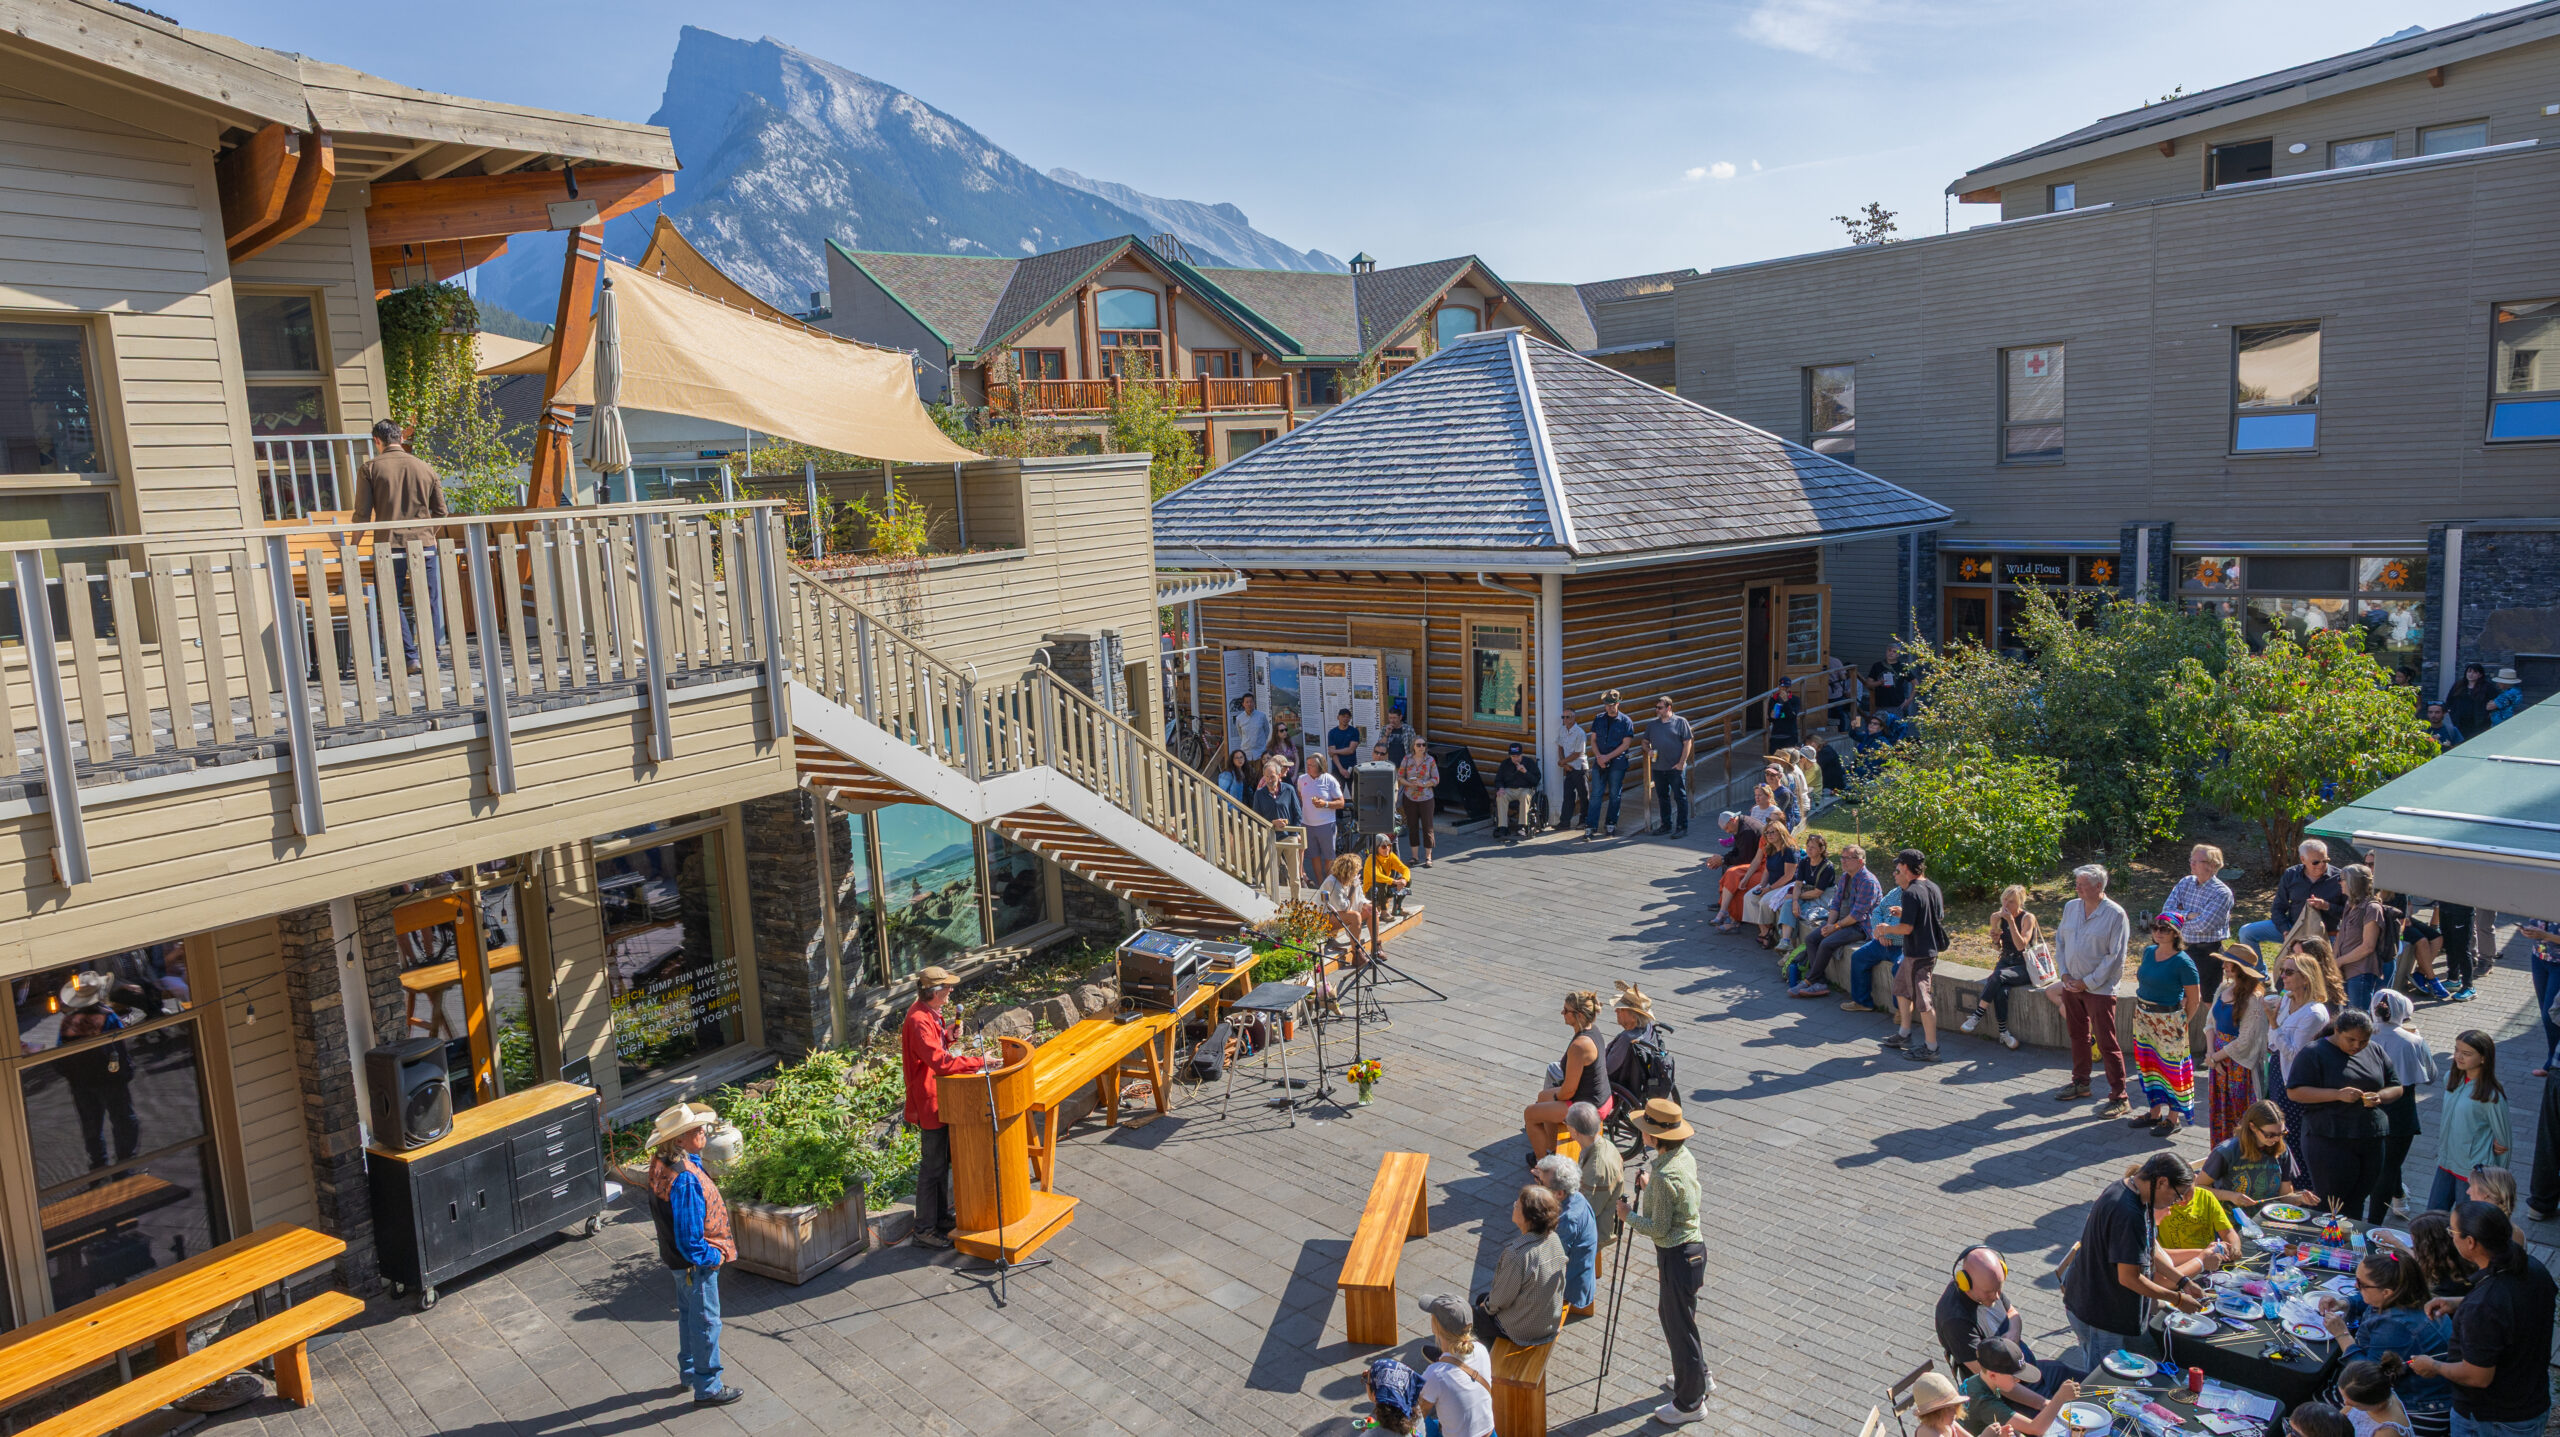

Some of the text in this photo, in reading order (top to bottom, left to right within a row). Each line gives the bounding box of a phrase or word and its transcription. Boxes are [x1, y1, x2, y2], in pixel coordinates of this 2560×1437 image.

[610, 956, 737, 1007] TRETCH JUMP FUN WALK SWI
[612, 968, 738, 1020] OVE PLAY LAUGH LIVE GLO
[614, 1018, 639, 1032] OGA
[641, 1009, 661, 1023] RUN
[664, 1000, 687, 1014] SING
[690, 987, 721, 1005] DANCE
[616, 992, 740, 1044] ADDLE DANCE SING MEDITA
[617, 1041, 644, 1057] AUGH
[671, 1020, 699, 1036] GLOW
[702, 1009, 729, 1024] YOGA
[732, 1004, 743, 1014] RU
